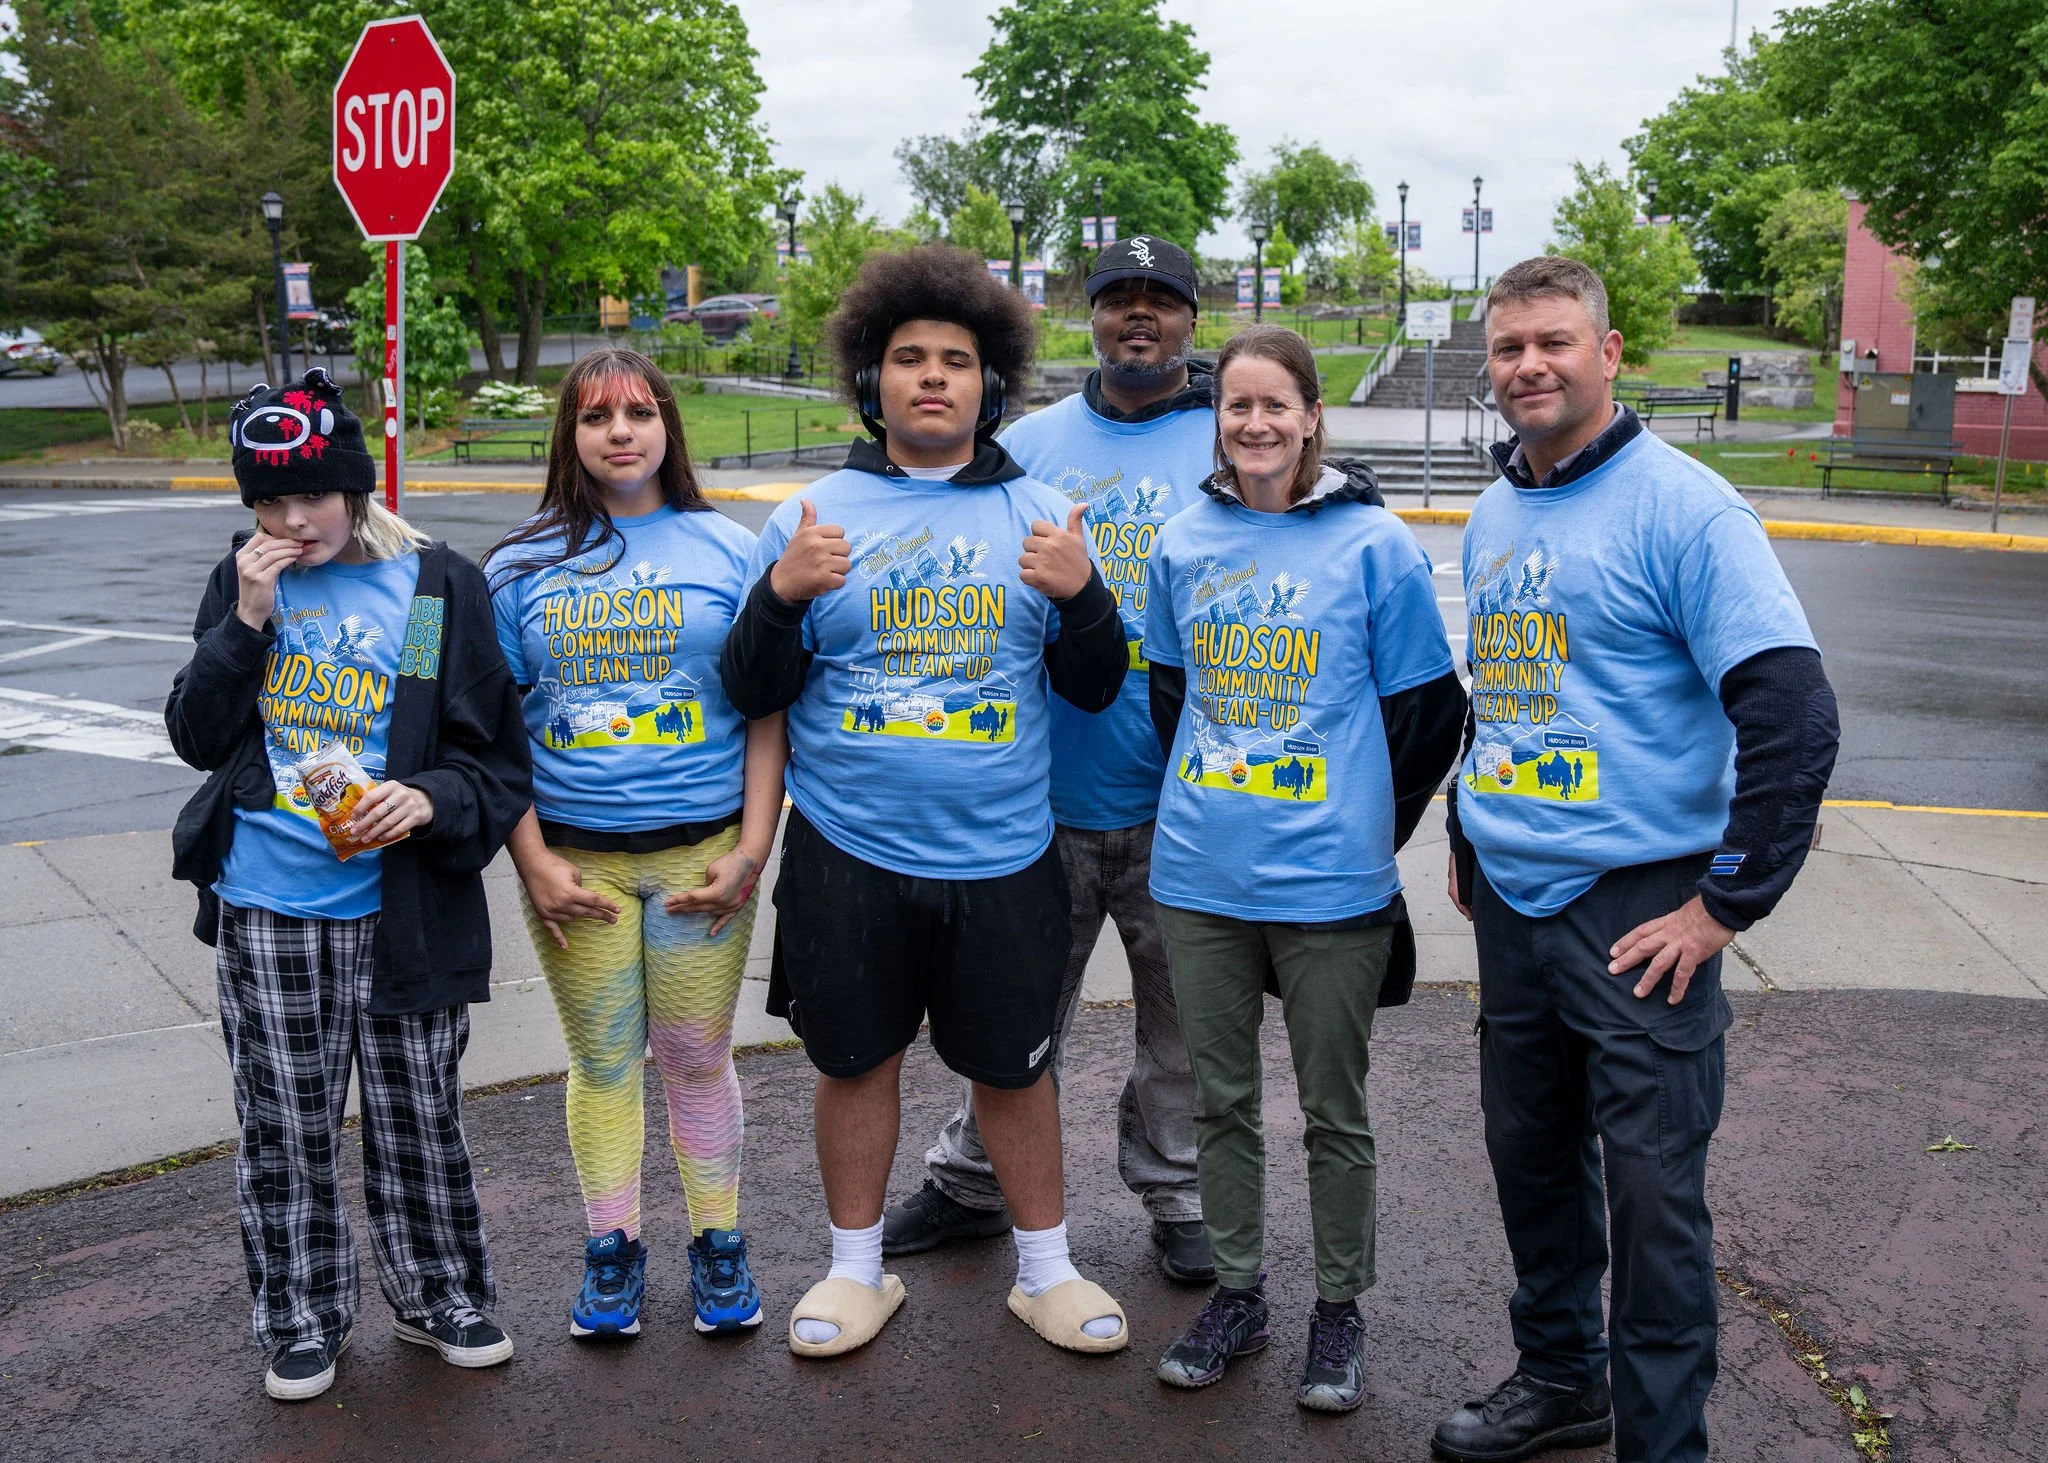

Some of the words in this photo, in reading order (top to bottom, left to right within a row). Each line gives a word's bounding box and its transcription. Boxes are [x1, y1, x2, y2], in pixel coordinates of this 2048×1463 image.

[342, 87, 446, 172] STOP
[895, 525, 934, 560] Annual
[1091, 521, 1165, 560] DSO
[1218, 560, 1259, 593] Annual
[544, 587, 684, 634] HUDSON
[871, 584, 1006, 632] HUDSON
[549, 628, 679, 660] COMMUNITY
[877, 628, 1000, 655] COMMUNITY
[1193, 620, 1320, 677] HUDSON
[559, 655, 672, 687] CLEAN-UP
[883, 651, 993, 681] CLEAN-UP
[1199, 667, 1311, 704] COMMUNITY
[1202, 697, 1300, 732] CLEAN-UP
[1287, 744, 1305, 752] HUDSON
[1548, 737, 1569, 745] HUDSON
[312, 769, 351, 807] Goldfish
